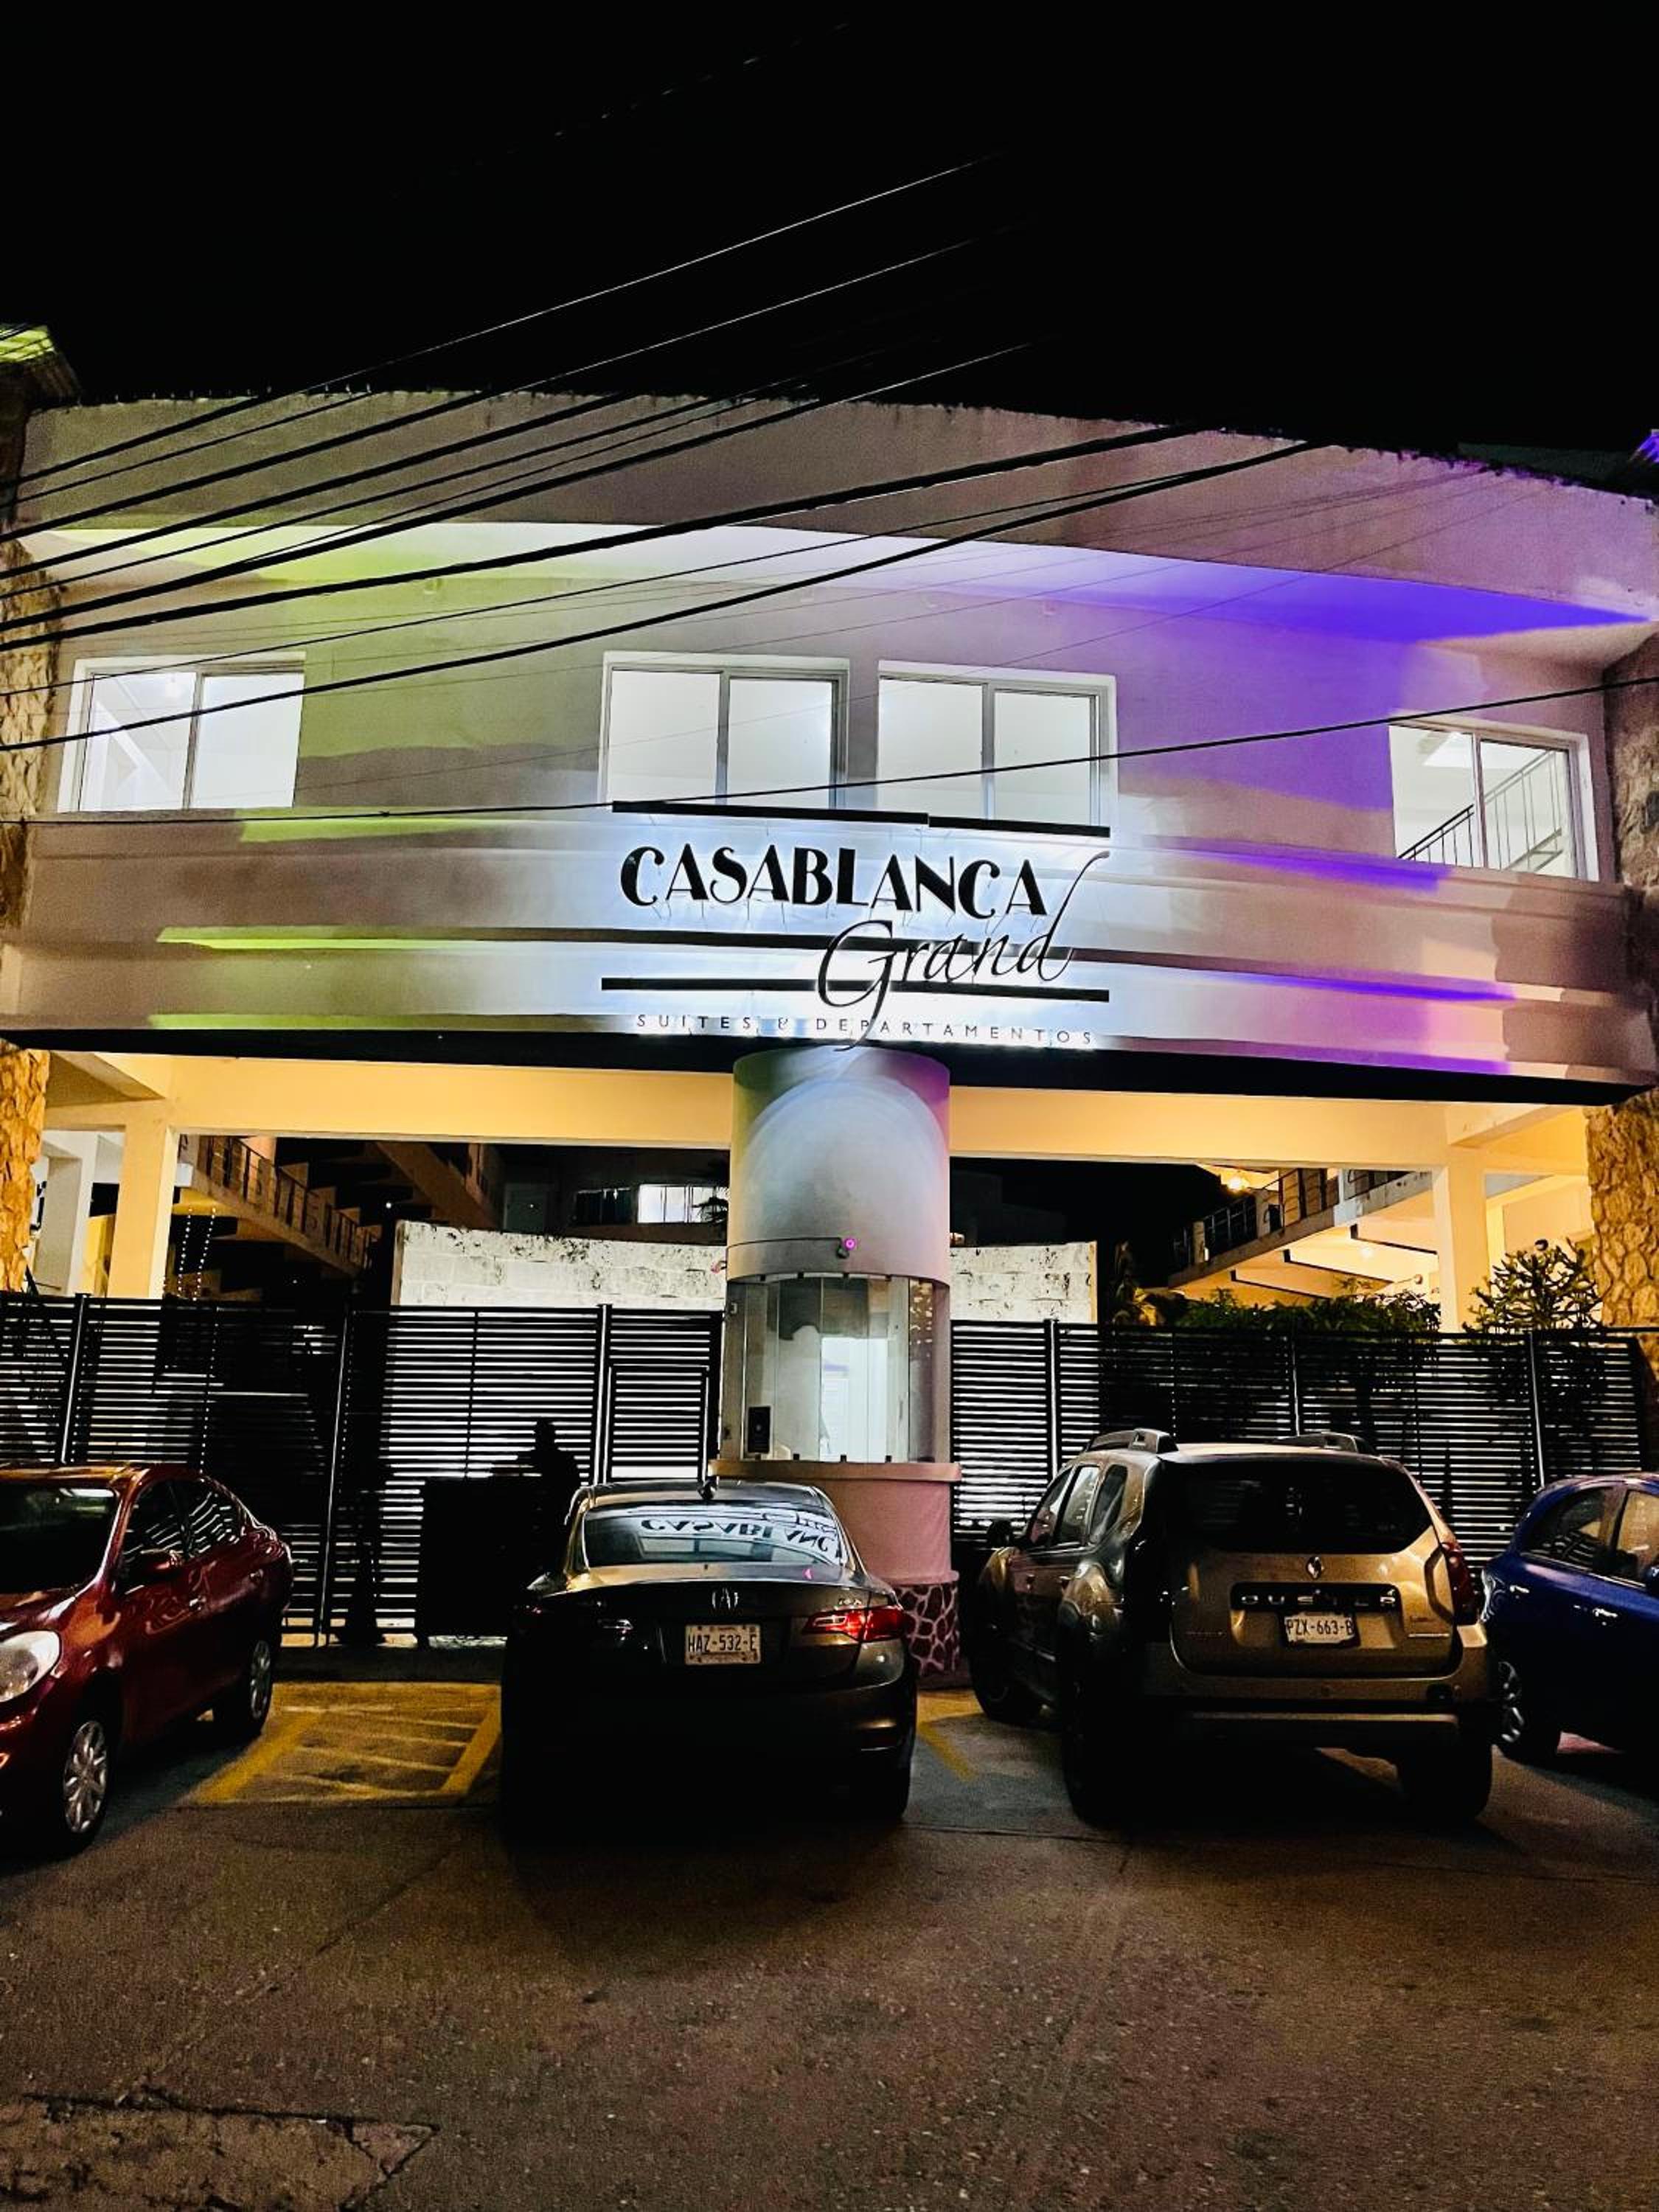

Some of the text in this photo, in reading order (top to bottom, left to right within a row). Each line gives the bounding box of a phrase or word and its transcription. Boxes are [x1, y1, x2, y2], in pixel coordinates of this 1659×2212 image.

[620, 843, 1048, 919] CASABLANCA
[816, 850, 1110, 1051] Grand
[636, 1014, 751, 1030] SUITES
[815, 1018, 1092, 1044] DEPARTAMENTOS
[688, 1633, 757, 1652] HAZ-532-E
